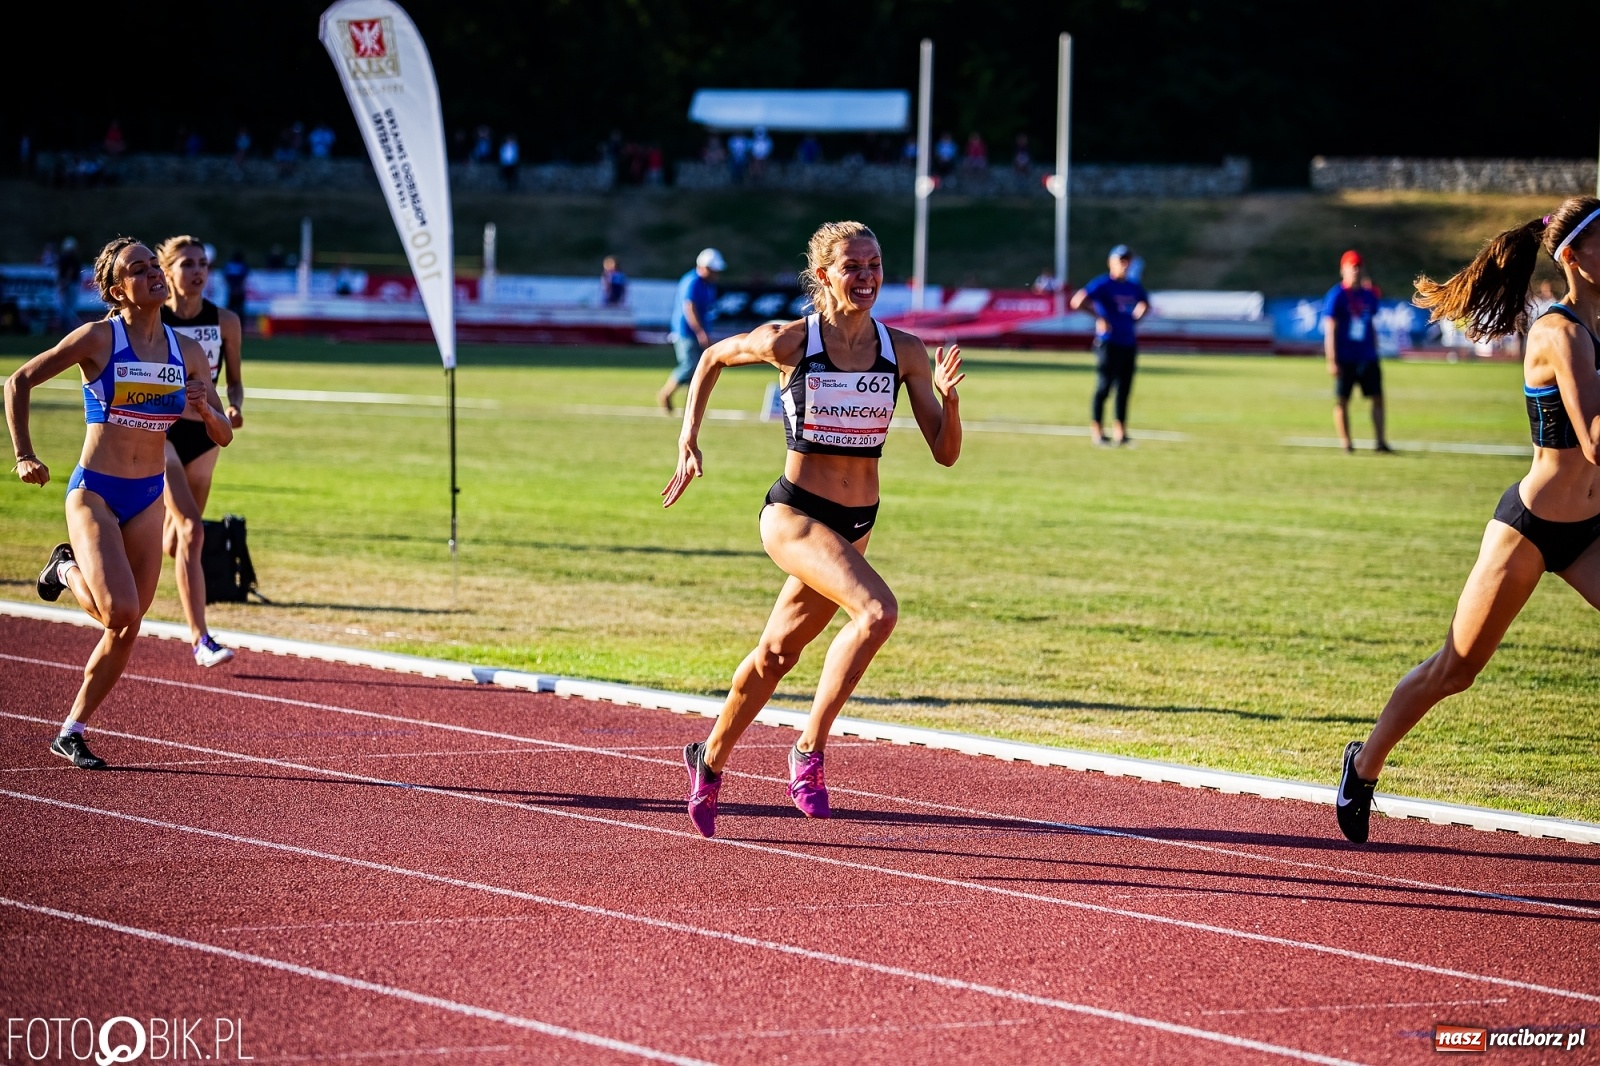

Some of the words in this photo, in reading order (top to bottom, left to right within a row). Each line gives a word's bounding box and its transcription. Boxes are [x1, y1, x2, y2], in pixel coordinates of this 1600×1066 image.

[194, 328, 218, 341] 358
[157, 366, 183, 383] 484
[855, 375, 891, 393] 662
[126, 391, 178, 407] KORBUT
[117, 417, 157, 429] RACIBÓRZ
[813, 434, 857, 445] RACIBÓRZ
[858, 436, 877, 445] 2019
